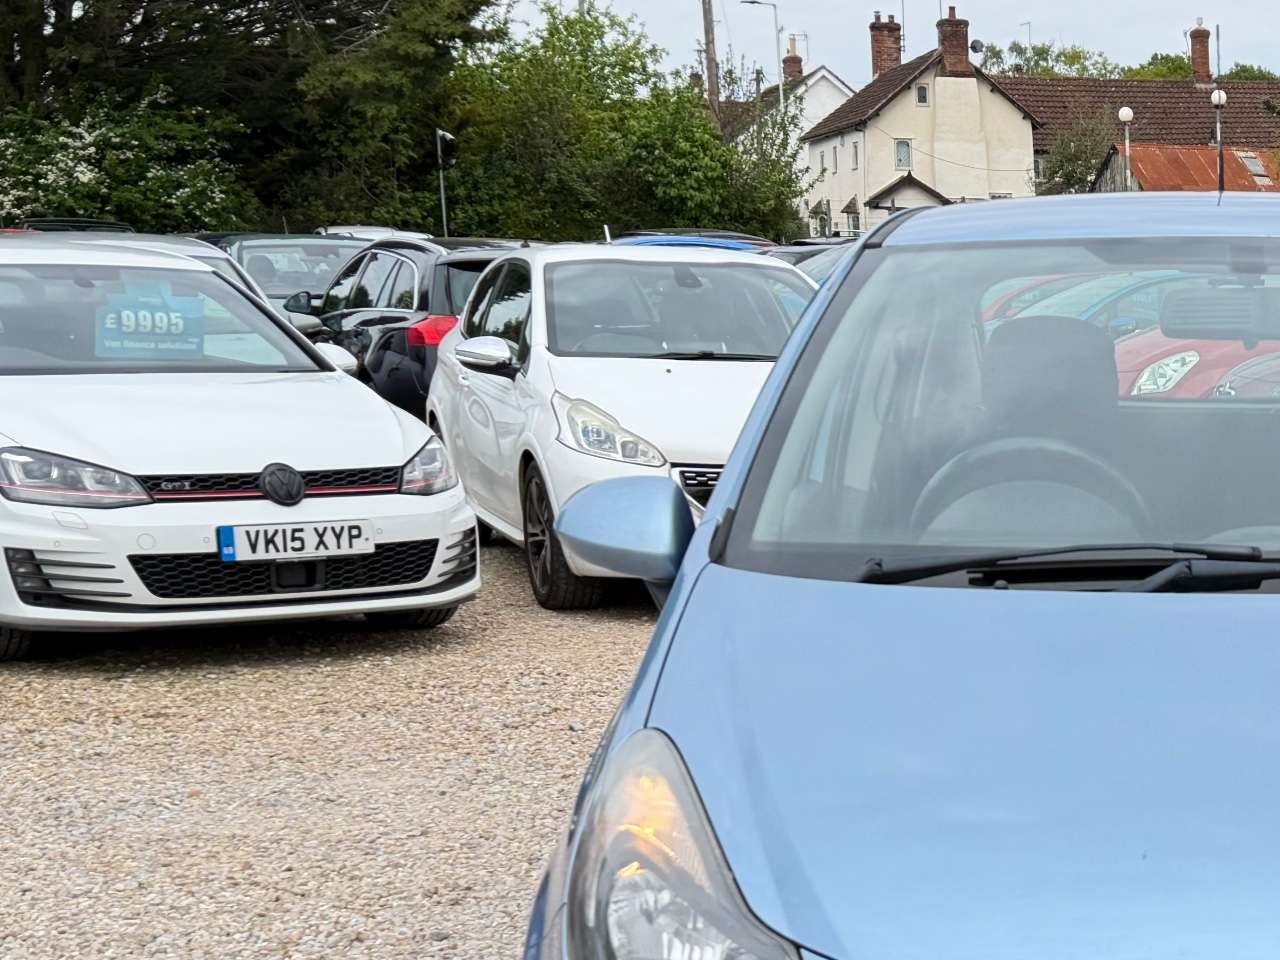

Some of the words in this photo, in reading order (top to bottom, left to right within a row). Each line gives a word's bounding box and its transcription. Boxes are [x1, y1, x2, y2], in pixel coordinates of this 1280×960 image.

[160, 481, 192, 490] GTI
[245, 528, 305, 554] VK15
[313, 525, 362, 551] XYP
